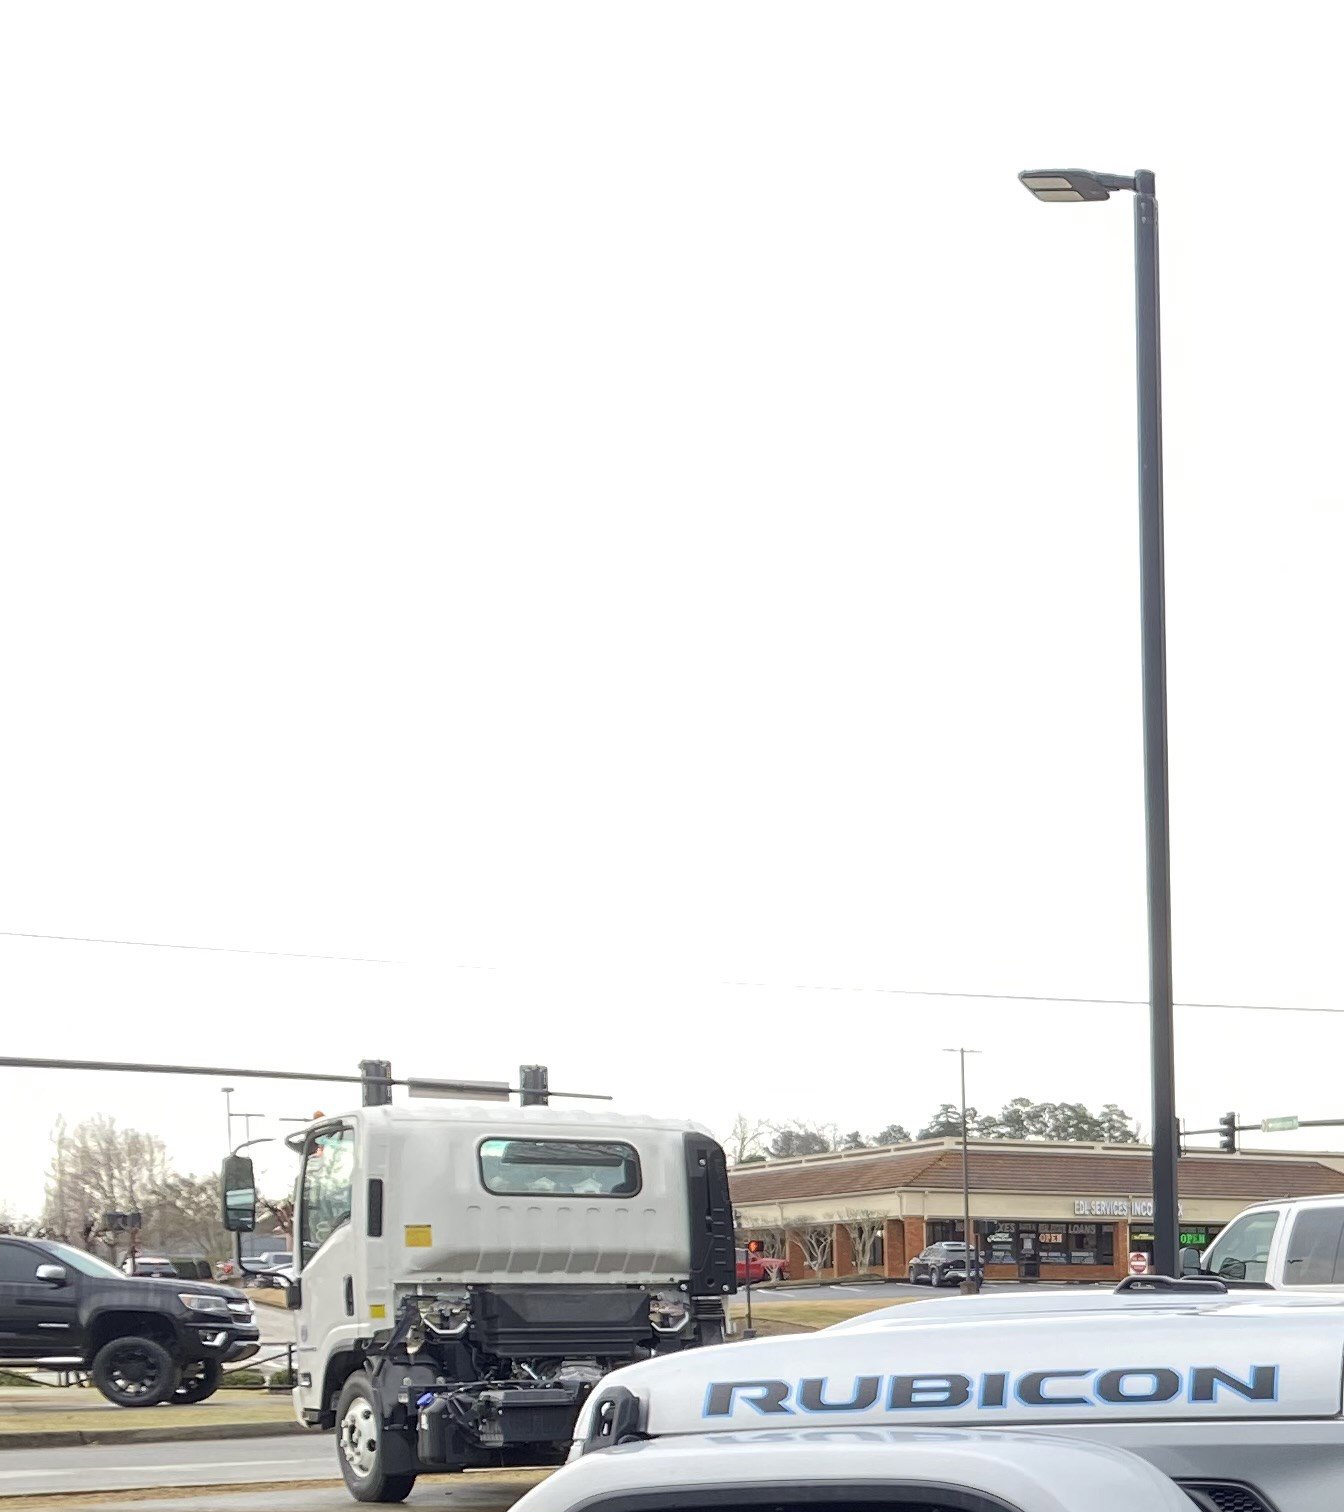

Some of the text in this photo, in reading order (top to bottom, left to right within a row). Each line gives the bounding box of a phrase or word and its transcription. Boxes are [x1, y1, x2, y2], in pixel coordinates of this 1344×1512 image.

[1090, 1200, 1128, 1217] SERVICES
[1131, 1201, 1154, 1217] INCO
[1068, 1223, 1096, 1234] LOANS
[1039, 1233, 1063, 1243] OPEN
[1180, 1233, 1206, 1244] OPEN
[702, 1363, 1280, 1418] RUBICON
